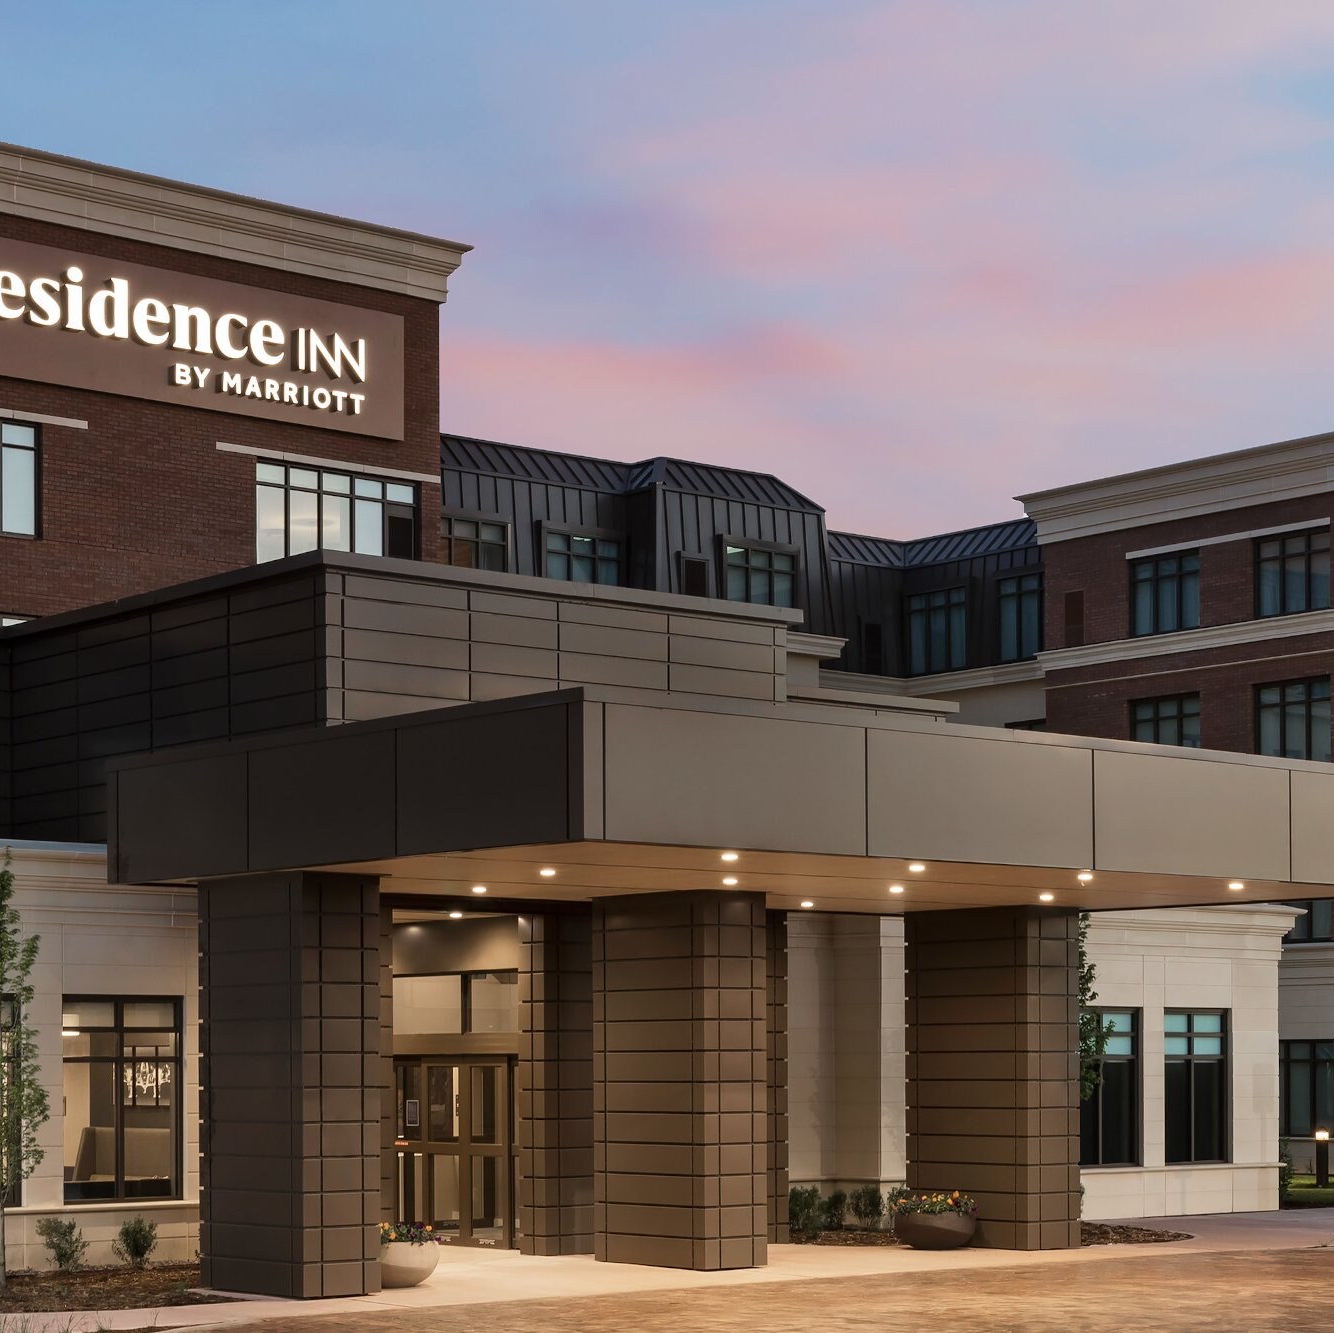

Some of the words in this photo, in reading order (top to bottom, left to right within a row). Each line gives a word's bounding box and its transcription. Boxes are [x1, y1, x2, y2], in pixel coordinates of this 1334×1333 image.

[297, 327, 366, 383] INN
[174, 362, 211, 388] BY
[222, 371, 366, 415] MARRIOTT
